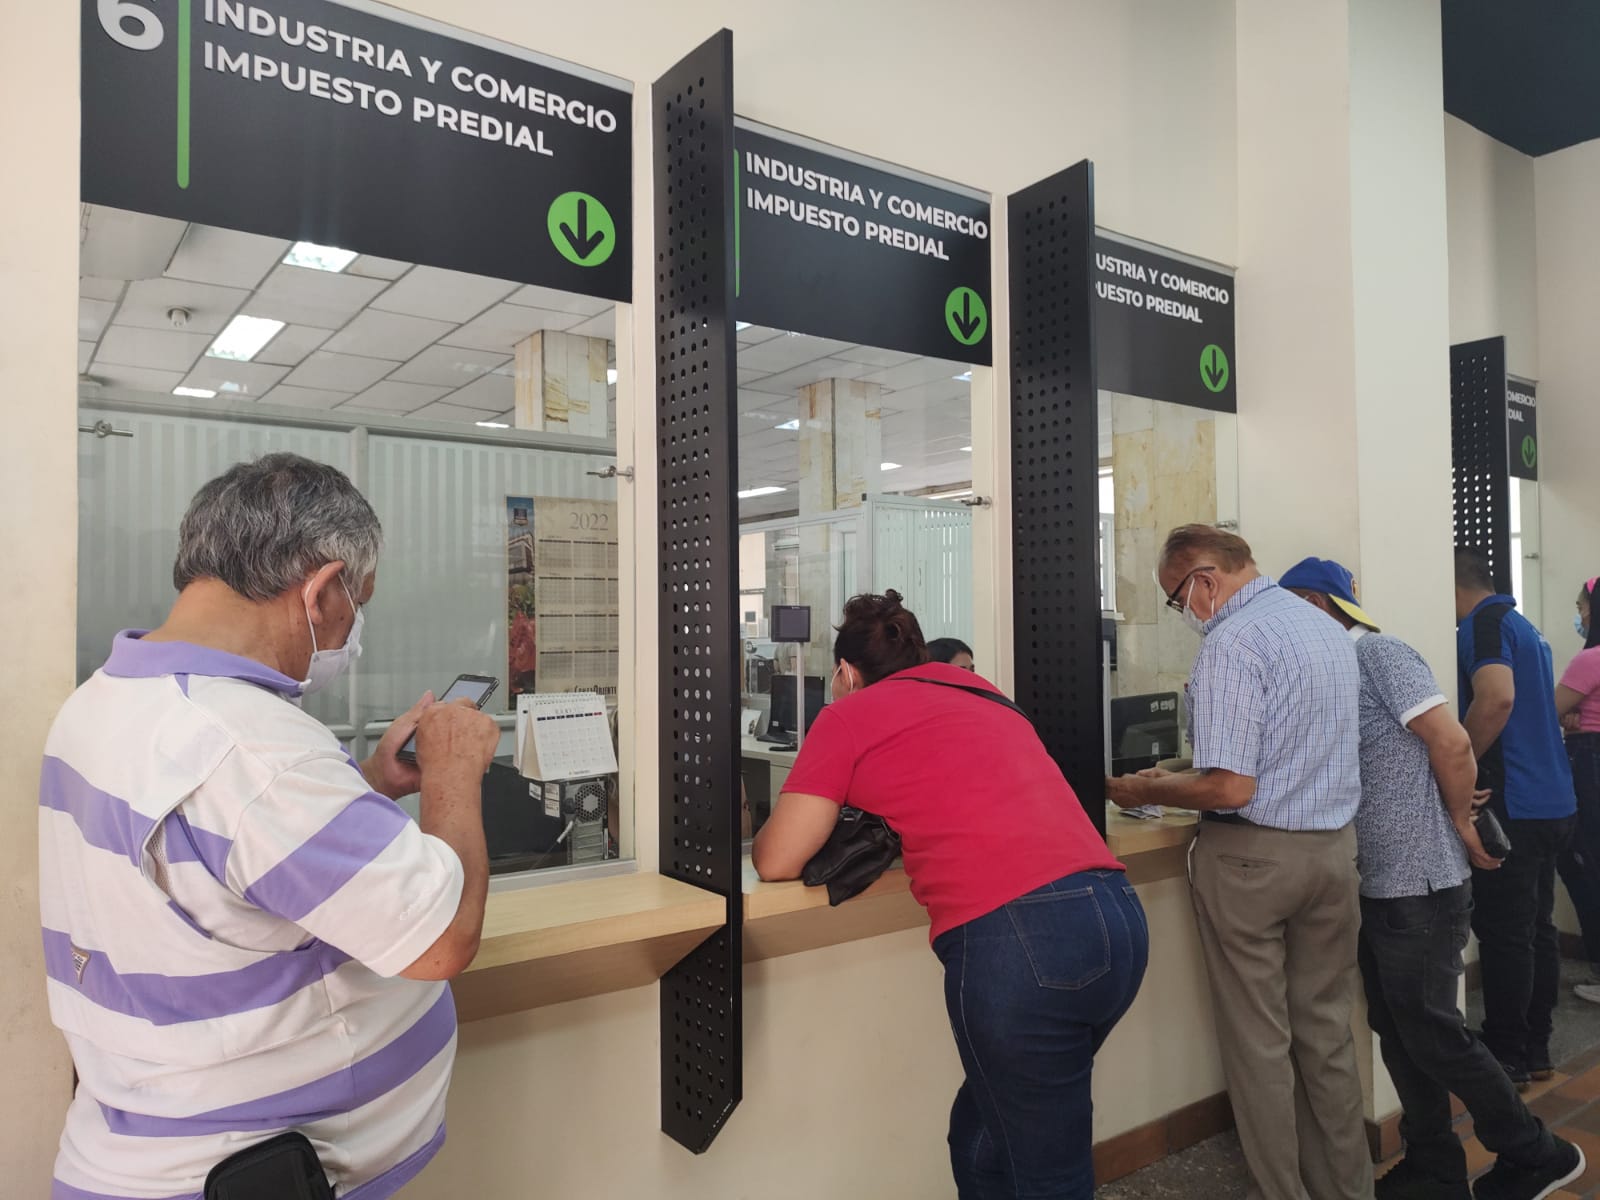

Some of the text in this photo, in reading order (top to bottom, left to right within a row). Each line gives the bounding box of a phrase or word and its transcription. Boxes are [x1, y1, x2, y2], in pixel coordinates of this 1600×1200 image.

[98, 0, 164, 50] 6
[205, 0, 617, 133] INDUSTRIA Y COMERCIO
[204, 41, 553, 156] IMPUESTO PREDIAL
[746, 151, 988, 239] INDUSTRIA Y COMERCIO
[747, 187, 950, 261] IMPUESTO PREDIAL
[1095, 280, 1203, 324] UESTO PREDIAL
[1148, 267, 1158, 285] Y
[1160, 272, 1229, 305] COMERCIO
[569, 511, 609, 531] 2022
